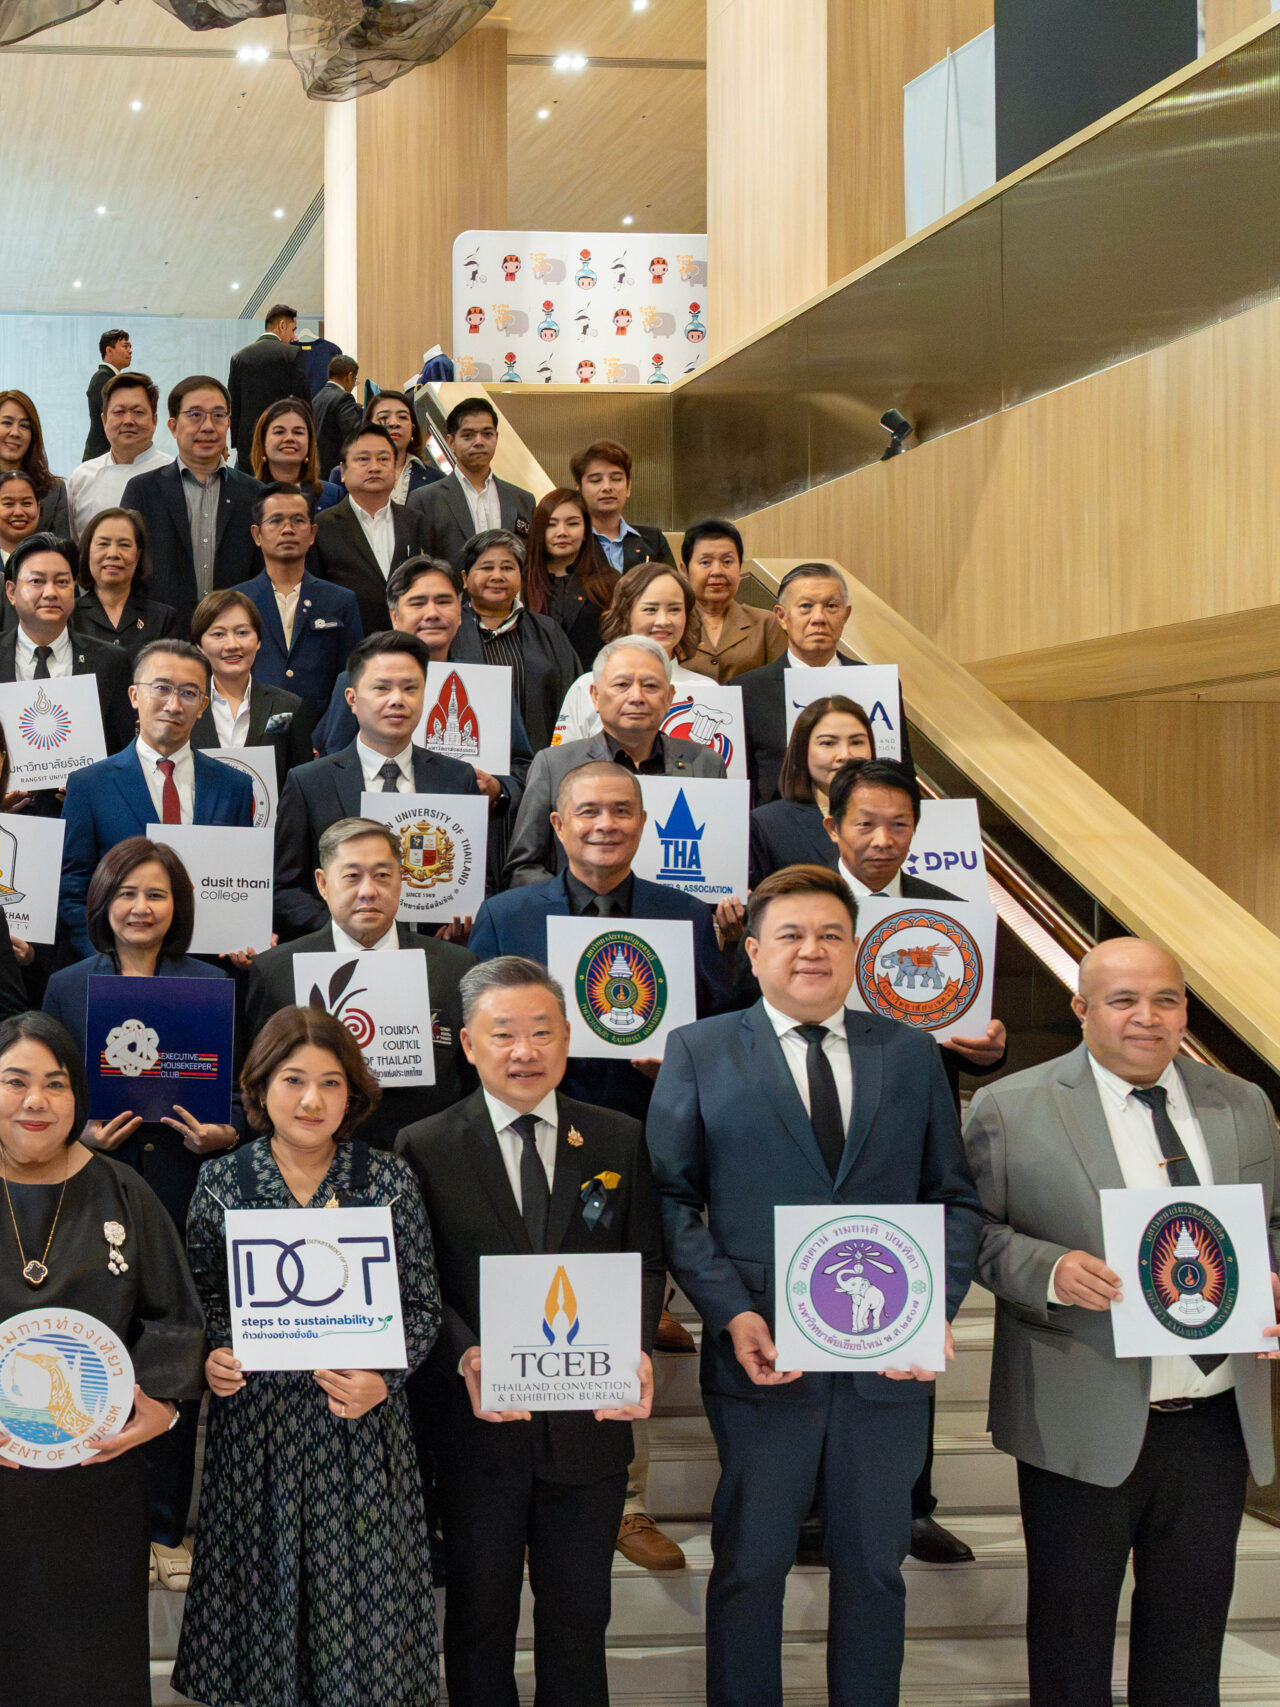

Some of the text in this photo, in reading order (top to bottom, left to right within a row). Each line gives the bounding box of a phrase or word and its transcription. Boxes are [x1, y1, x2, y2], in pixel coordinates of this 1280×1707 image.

[20, 774, 48, 783] RANGSIT
[394, 808, 473, 886] UNIVERSITY OF THAILAND
[660, 839, 702, 869] THA
[923, 850, 978, 871] DPU
[201, 876, 270, 889] dusit thani
[683, 884, 733, 894] ASSOCIATION
[200, 889, 249, 903] college
[379, 1025, 420, 1036] TOURISM
[382, 1039, 421, 1051] COUNCIL
[160, 1052, 199, 1061] EXECUTIVE
[377, 1054, 422, 1066] THAILAND
[160, 1062, 212, 1071] HOUSEKEEPER
[160, 1070, 180, 1079] CLUB
[241, 1314, 375, 1329] steps to sustainability
[510, 1351, 612, 1378] TCEB
[491, 1380, 632, 1392] THAILAND CONVENTION
[497, 1391, 625, 1402] & EXHIBITION BUREAU
[46, 1449, 65, 1462] OF
[71, 1404, 122, 1455] TOURISM
